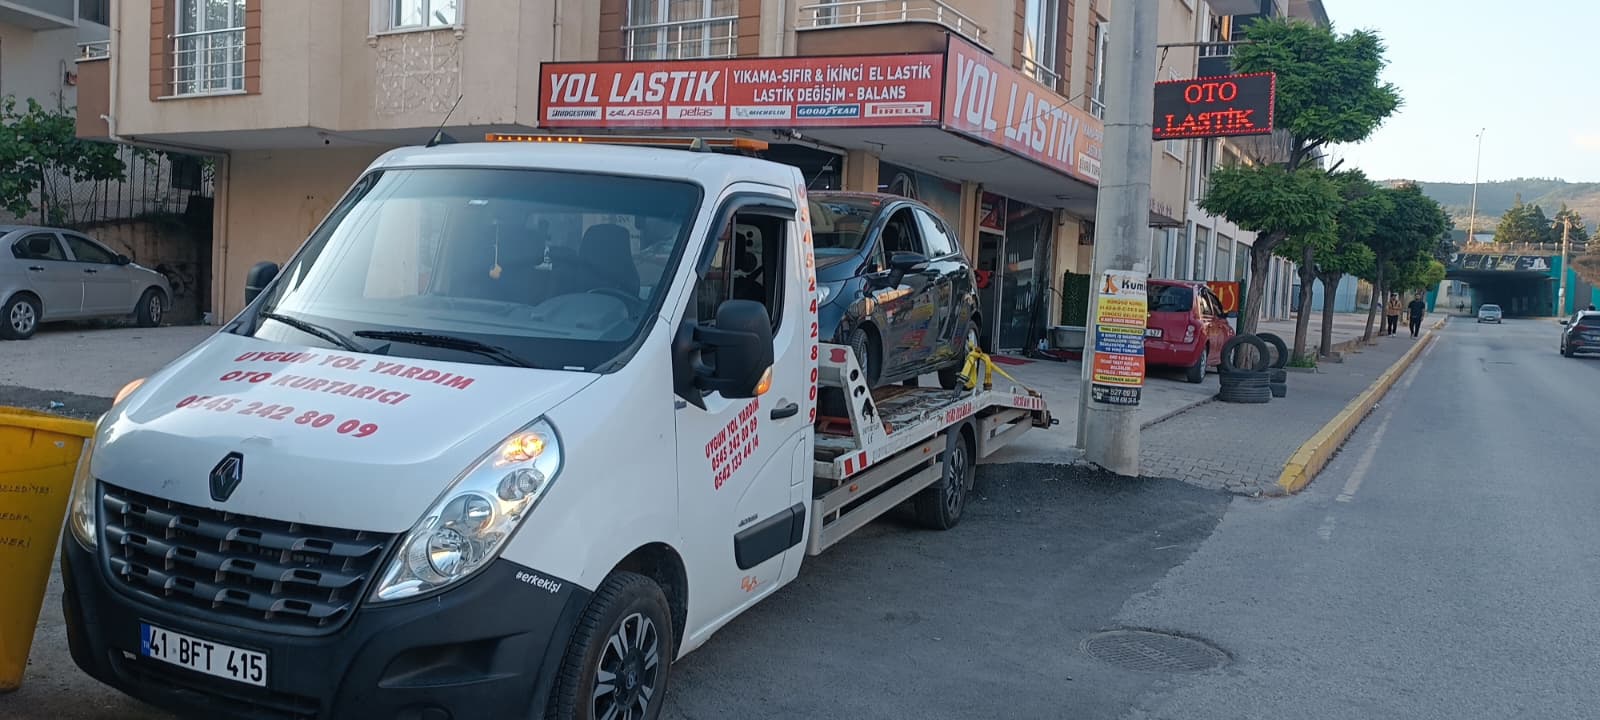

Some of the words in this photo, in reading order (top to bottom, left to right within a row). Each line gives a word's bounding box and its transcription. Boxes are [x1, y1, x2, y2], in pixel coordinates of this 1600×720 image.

[549, 72, 600, 103] YOL
[733, 67, 812, 84] YIKAMA-SIFIR
[815, 68, 825, 82] &
[826, 63, 863, 81] İKİNCİ
[869, 67, 884, 80] EL
[886, 62, 932, 80] LASTİK
[753, 86, 795, 102] LASTİK
[797, 83, 845, 103] DEĞİŞİM
[857, 86, 906, 101] BALANS
[953, 52, 999, 133] YOL
[1184, 81, 1237, 104] OTO
[552, 109, 598, 118] BRIDGESTONE
[749, 109, 786, 117] MICHELIN
[798, 105, 857, 116] GOODYEAR
[871, 103, 925, 115] PIRELLI
[234, 352, 317, 364] UYGUN
[318, 354, 367, 370] YOL
[369, 360, 475, 390] YARDIM
[219, 370, 272, 384] OTO
[270, 375, 411, 405] KURTARICI
[175, 395, 241, 411] 0545
[237, 401, 295, 421] 242
[294, 410, 336, 428] 80
[336, 419, 378, 438] 09
[705, 429, 726, 459] UYGUN
[727, 417, 738, 434] YOL
[739, 397, 760, 426] YARDIM
[712, 447, 728, 472] 0545
[729, 433, 741, 454] 242
[742, 425, 749, 441] 80
[749, 417, 758, 432] 09
[714, 465, 731, 490] 0542
[731, 452, 742, 474] 133
[515, 571, 562, 593] #erkekişi
[150, 626, 167, 658] 41
[179, 637, 214, 671] BFT
[226, 650, 263, 682] 415
